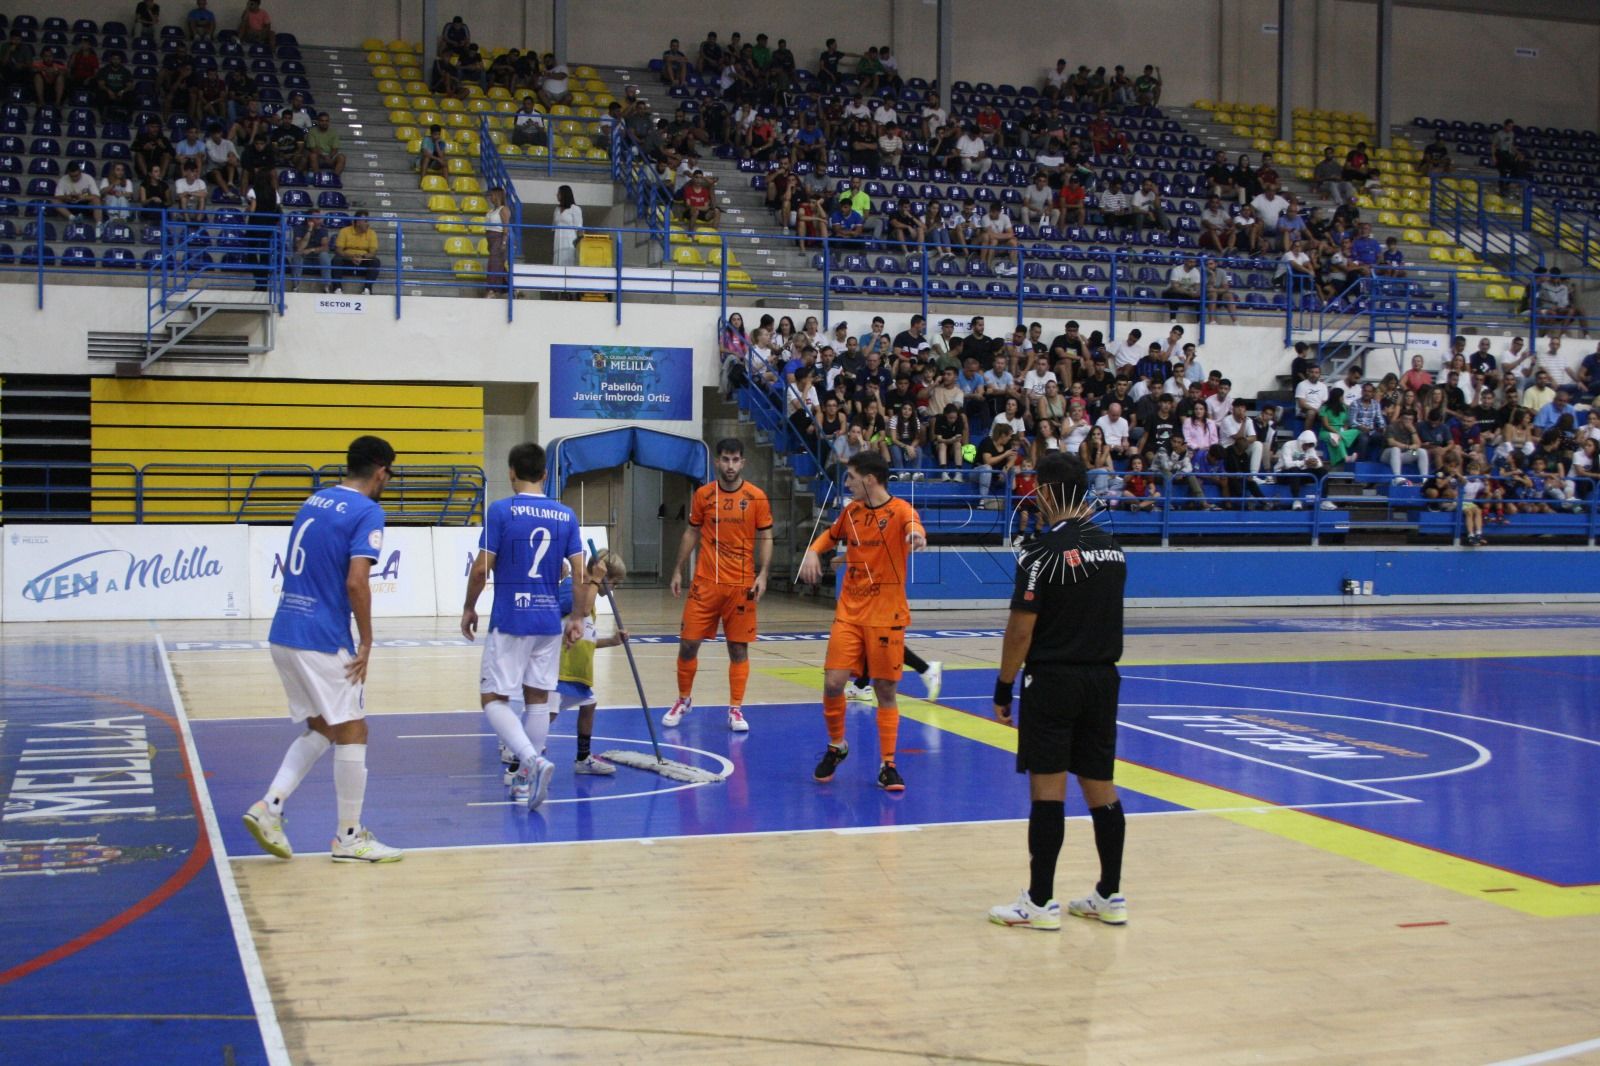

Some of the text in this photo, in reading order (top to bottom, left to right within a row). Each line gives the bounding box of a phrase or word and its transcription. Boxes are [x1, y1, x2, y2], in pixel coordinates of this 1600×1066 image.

[354, 302, 362, 311] 2
[610, 360, 655, 371] MELILLA
[601, 382, 643, 392] Pabellón
[573, 392, 602, 401] Javier
[605, 392, 645, 402] Imbroda
[723, 499, 733, 511] 23
[865, 513, 875, 527] 17
[290, 518, 315, 575] 6
[528, 526, 551, 578] 2
[27, 545, 224, 604] VEN A Melilla
[2, 715, 156, 821] MELILLA
